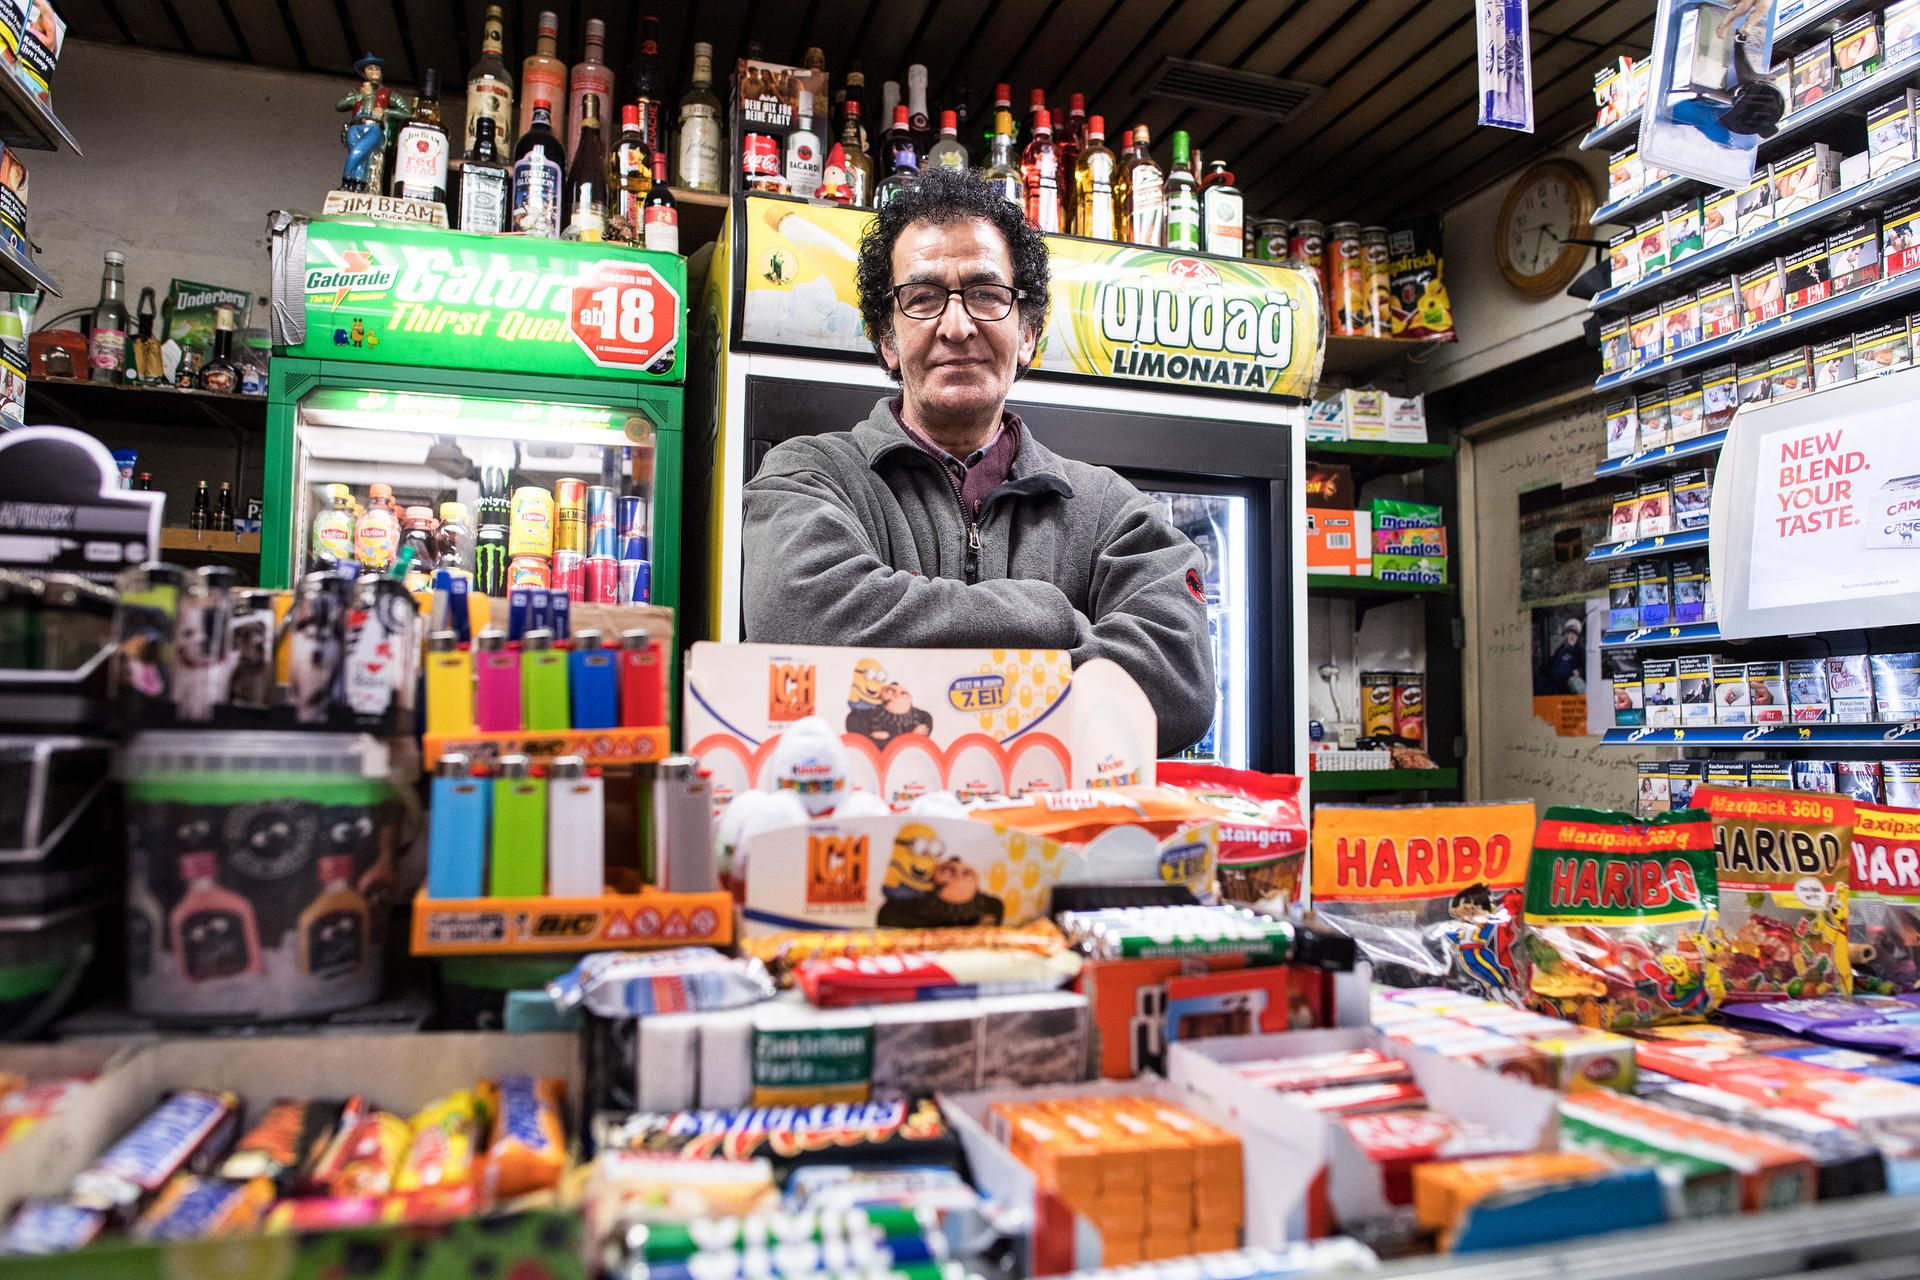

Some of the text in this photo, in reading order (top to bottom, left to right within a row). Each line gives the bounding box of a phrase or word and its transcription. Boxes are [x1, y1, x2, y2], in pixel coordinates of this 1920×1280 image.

[763, 101, 777, 113] MIX
[768, 112, 791, 126] PARTY
[337, 197, 434, 223] JIM BEAM
[306, 270, 392, 290] Gatorade
[1807, 283, 1825, 303] L&M
[177, 289, 246, 310] Underberg
[387, 302, 484, 337] Thirst
[580, 286, 655, 344] ab 18
[1102, 275, 1294, 370] uludağ
[1112, 340, 1266, 389] LİMONATA
[1781, 428, 1844, 464] NEW
[1779, 451, 1871, 488] BLEND.
[1777, 479, 1852, 513] YOUR
[522, 513, 545, 522] Lipton
[1775, 504, 1861, 538] TASTE.
[322, 530, 347, 539] Lipton
[361, 528, 387, 538] Lipton
[1385, 542, 1442, 556] mentos
[1381, 569, 1442, 584] mentos
[770, 664, 816, 705] ICH
[961, 688, 1004, 708] 7. EI!
[1710, 795, 1786, 818] Maxipack
[1337, 833, 1512, 889] HARIBO
[1714, 826, 1841, 876] HARIBO
[1551, 858, 1699, 908] HARIBO
